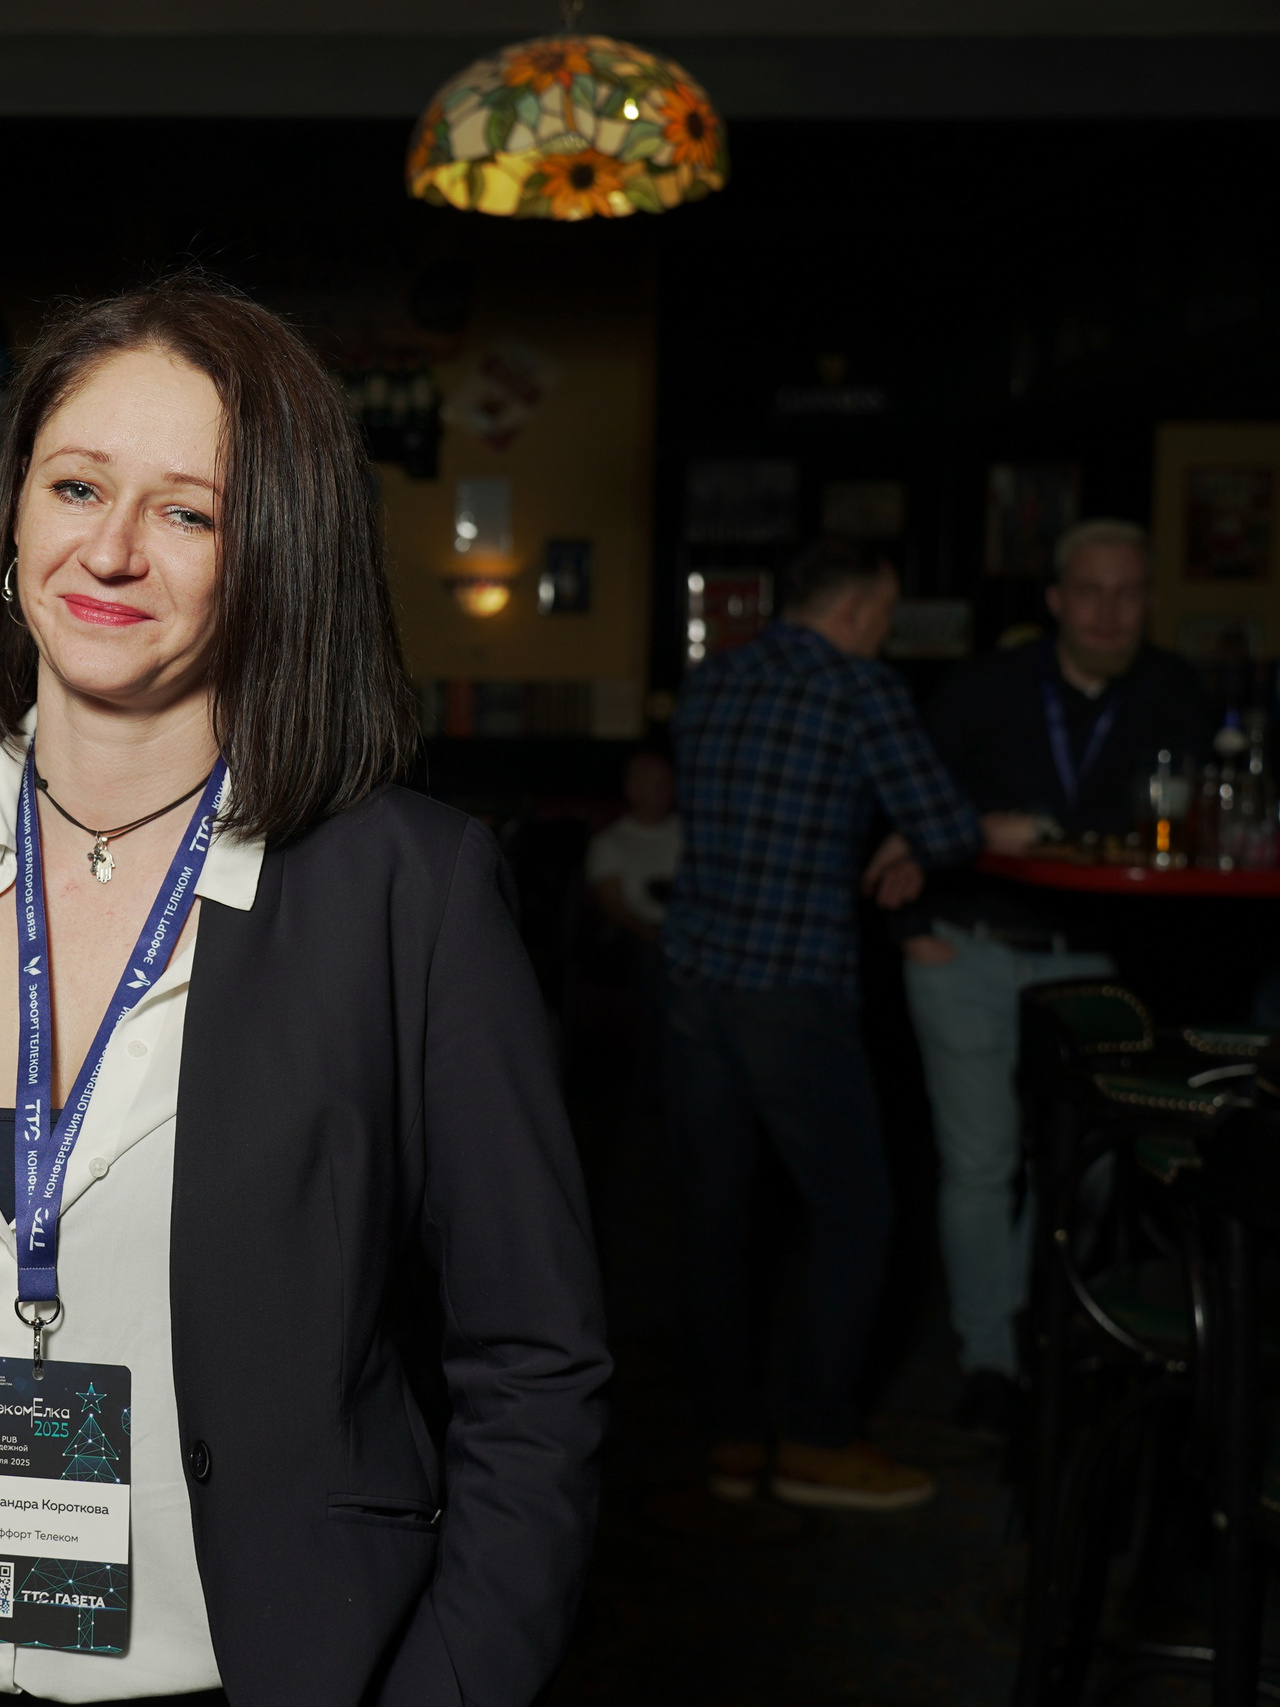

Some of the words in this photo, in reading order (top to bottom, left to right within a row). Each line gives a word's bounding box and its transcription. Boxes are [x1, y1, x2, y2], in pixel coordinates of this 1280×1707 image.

[24, 835, 34, 904] ОПЕРАТОРОВ
[25, 904, 37, 942] СВЯЗИ
[143, 918, 170, 965] ЭФФОРТ
[163, 866, 194, 921] ТЕЛЕКОМ
[28, 983, 40, 1031] ЭФФОРТ
[28, 1031, 40, 1085] ТЕЛЕКОМ
[43, 1113, 83, 1199] КОНФЕРЕНЦИЯ
[2, 1435, 18, 1444] PUB
[33, 1420, 70, 1438] 2025
[10, 1457, 31, 1467] 2025
[41, 1499, 110, 1515] Короткова
[34, 1530, 79, 1543] Телеком
